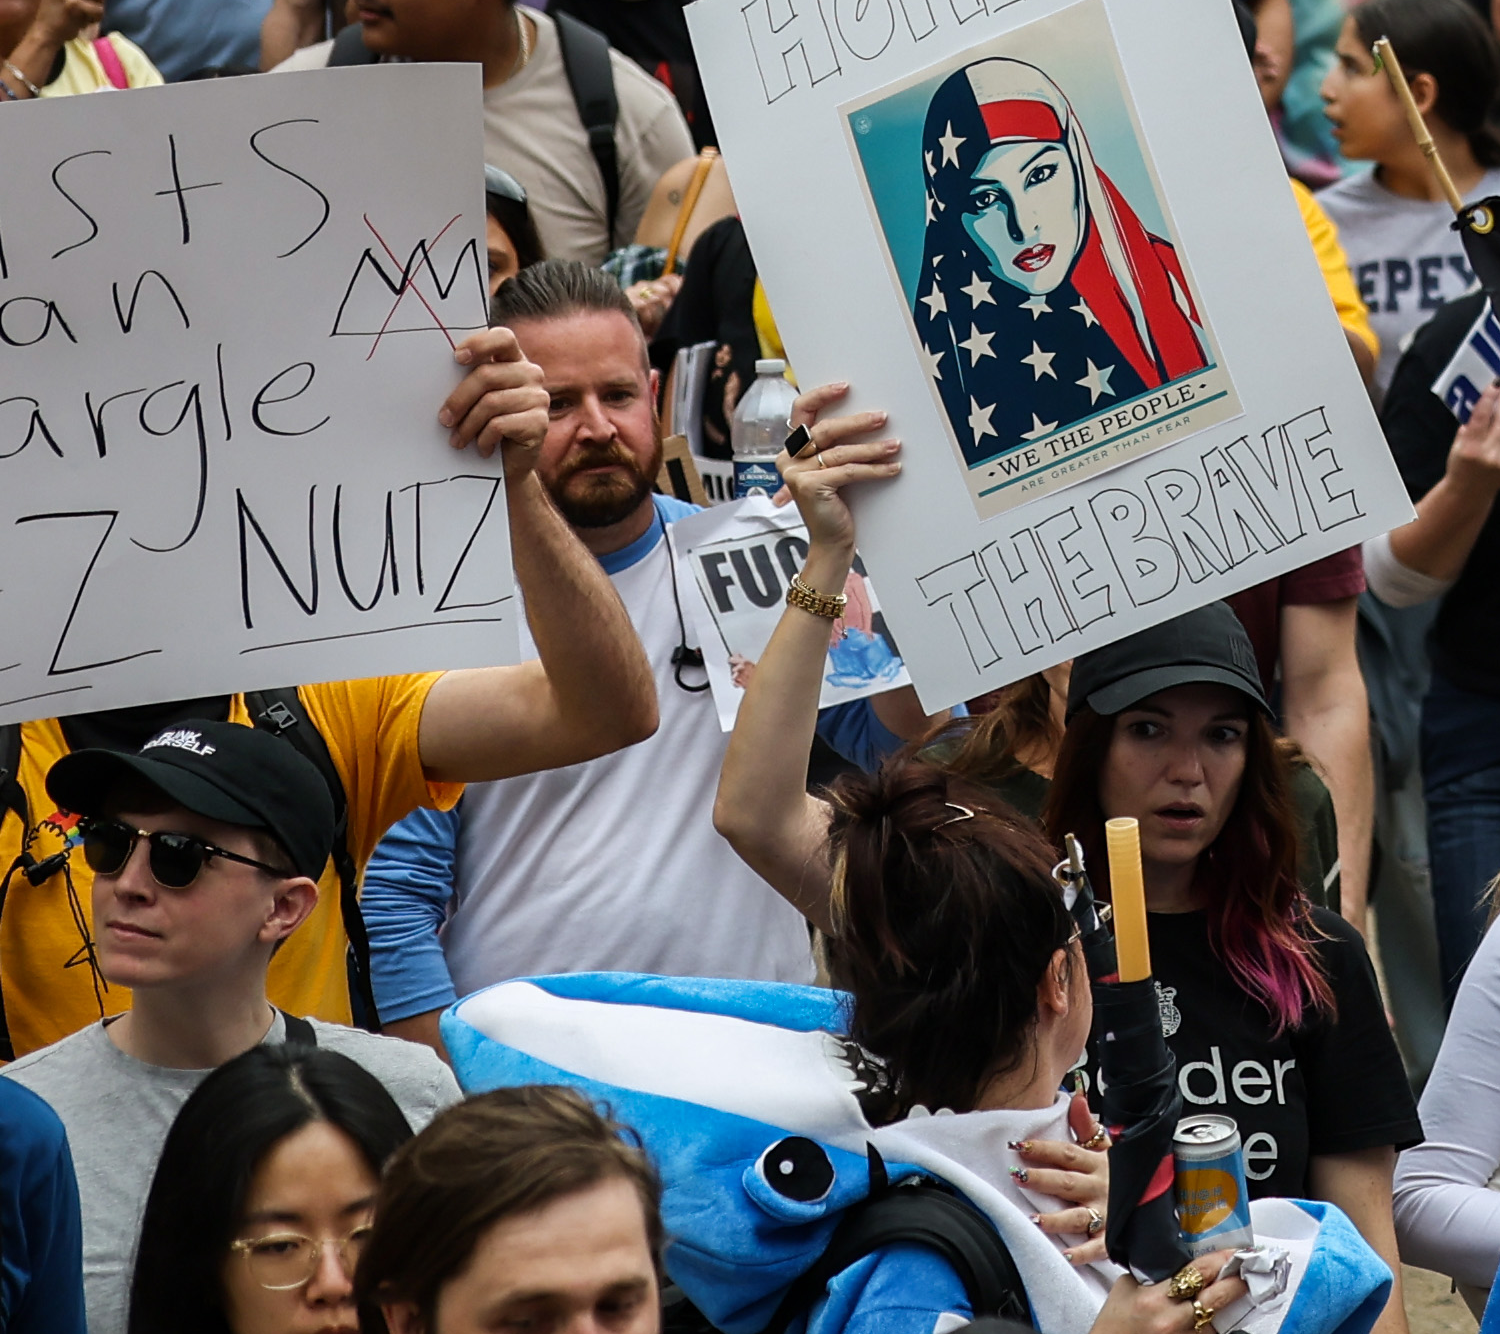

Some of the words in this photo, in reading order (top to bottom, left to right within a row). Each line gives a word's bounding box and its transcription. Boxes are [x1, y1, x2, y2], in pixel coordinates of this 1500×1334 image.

[996, 446, 1040, 481] WE
[1043, 429, 1095, 464] THE
[1097, 382, 1197, 446] PEOPLE
[1020, 475, 1043, 494] ARE
[1049, 448, 1119, 481] GREATER
[1122, 432, 1154, 455] THAN
[1156, 415, 1192, 437] FEAR
[235, 474, 514, 631] NUTZ
[689, 535, 810, 617] FUC
[915, 505, 1115, 678] THE
[1110, 405, 1370, 611] BRAVE
